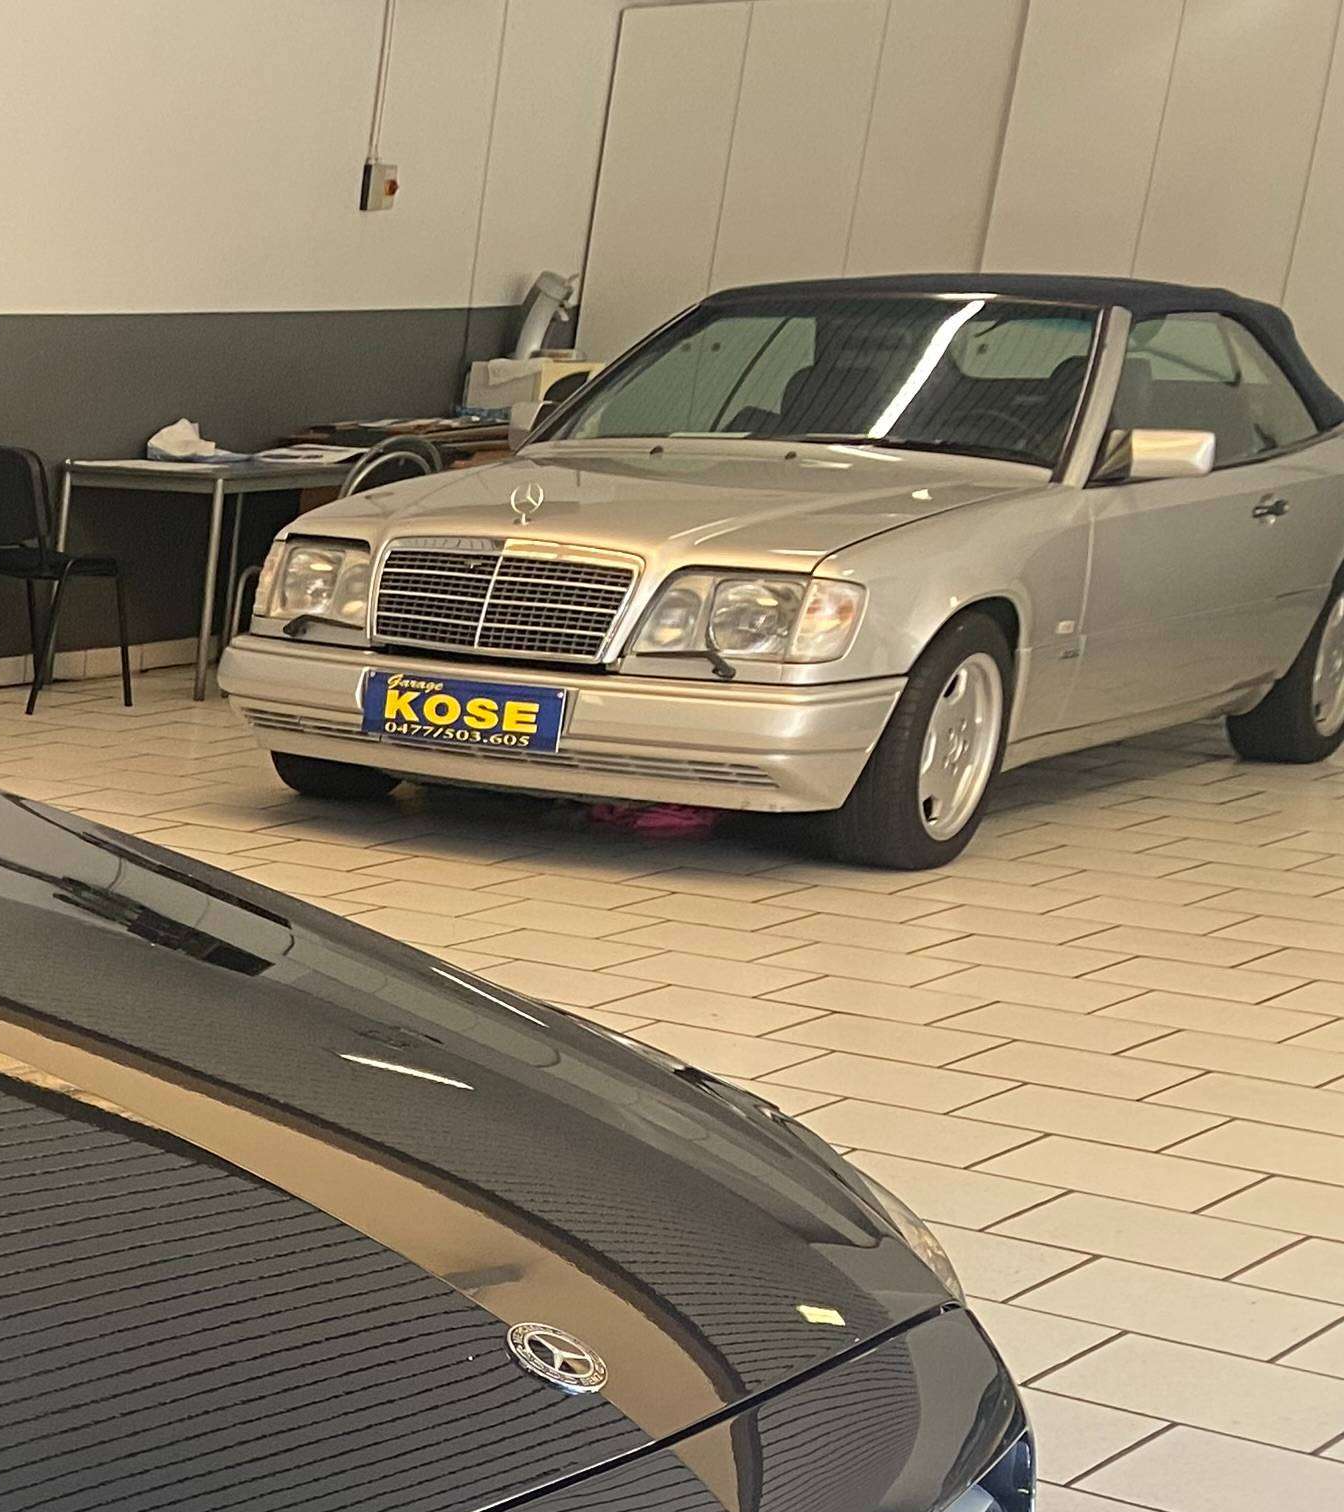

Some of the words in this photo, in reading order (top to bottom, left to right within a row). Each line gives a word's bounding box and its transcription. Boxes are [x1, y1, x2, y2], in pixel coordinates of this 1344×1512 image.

[386, 673, 443, 692] Garage
[384, 690, 540, 734] KOSE
[384, 721, 530, 747] 0477/503.605
